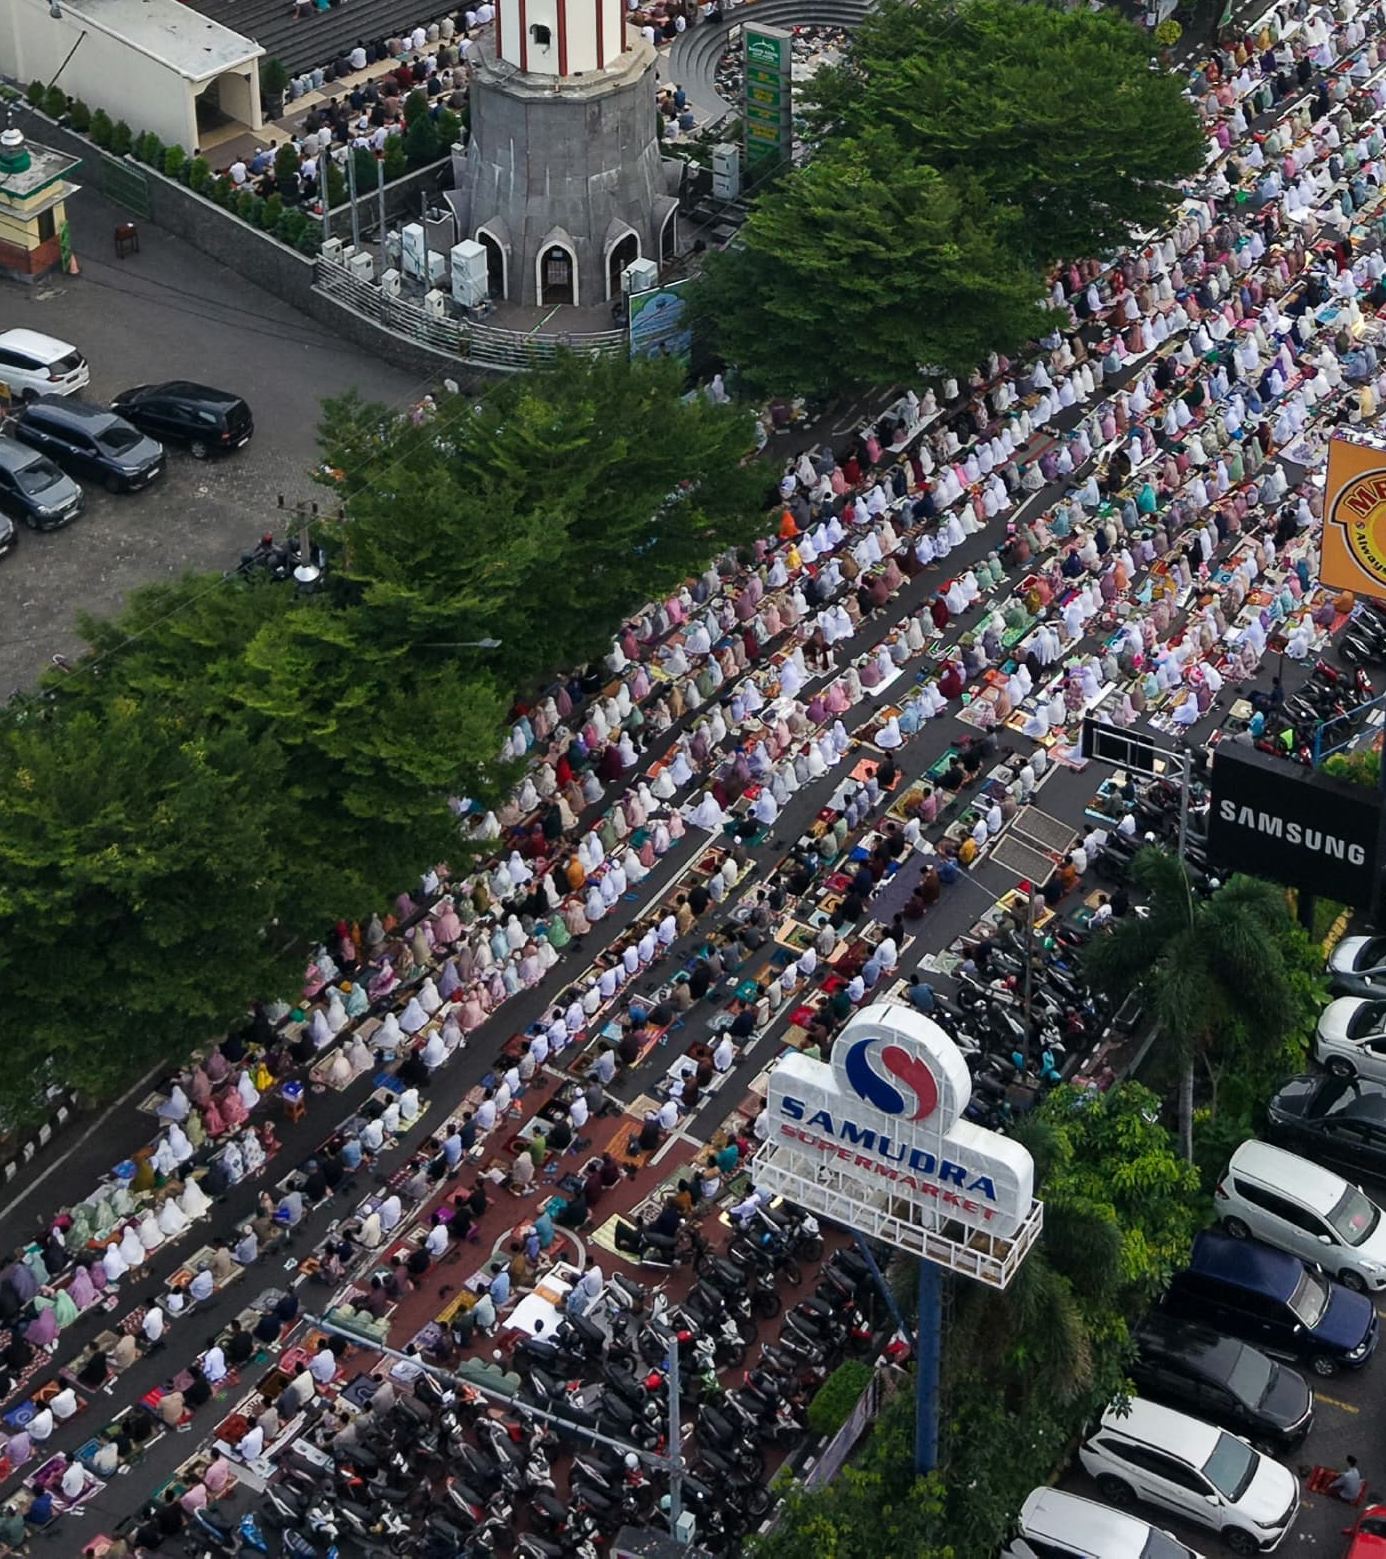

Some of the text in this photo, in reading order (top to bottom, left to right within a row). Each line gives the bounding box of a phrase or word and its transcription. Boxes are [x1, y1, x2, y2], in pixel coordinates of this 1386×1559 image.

[1219, 799, 1366, 866] SAMSUNG
[780, 1095, 998, 1201] SAMUDRA
[780, 1123, 998, 1222] SUPERMARKET
